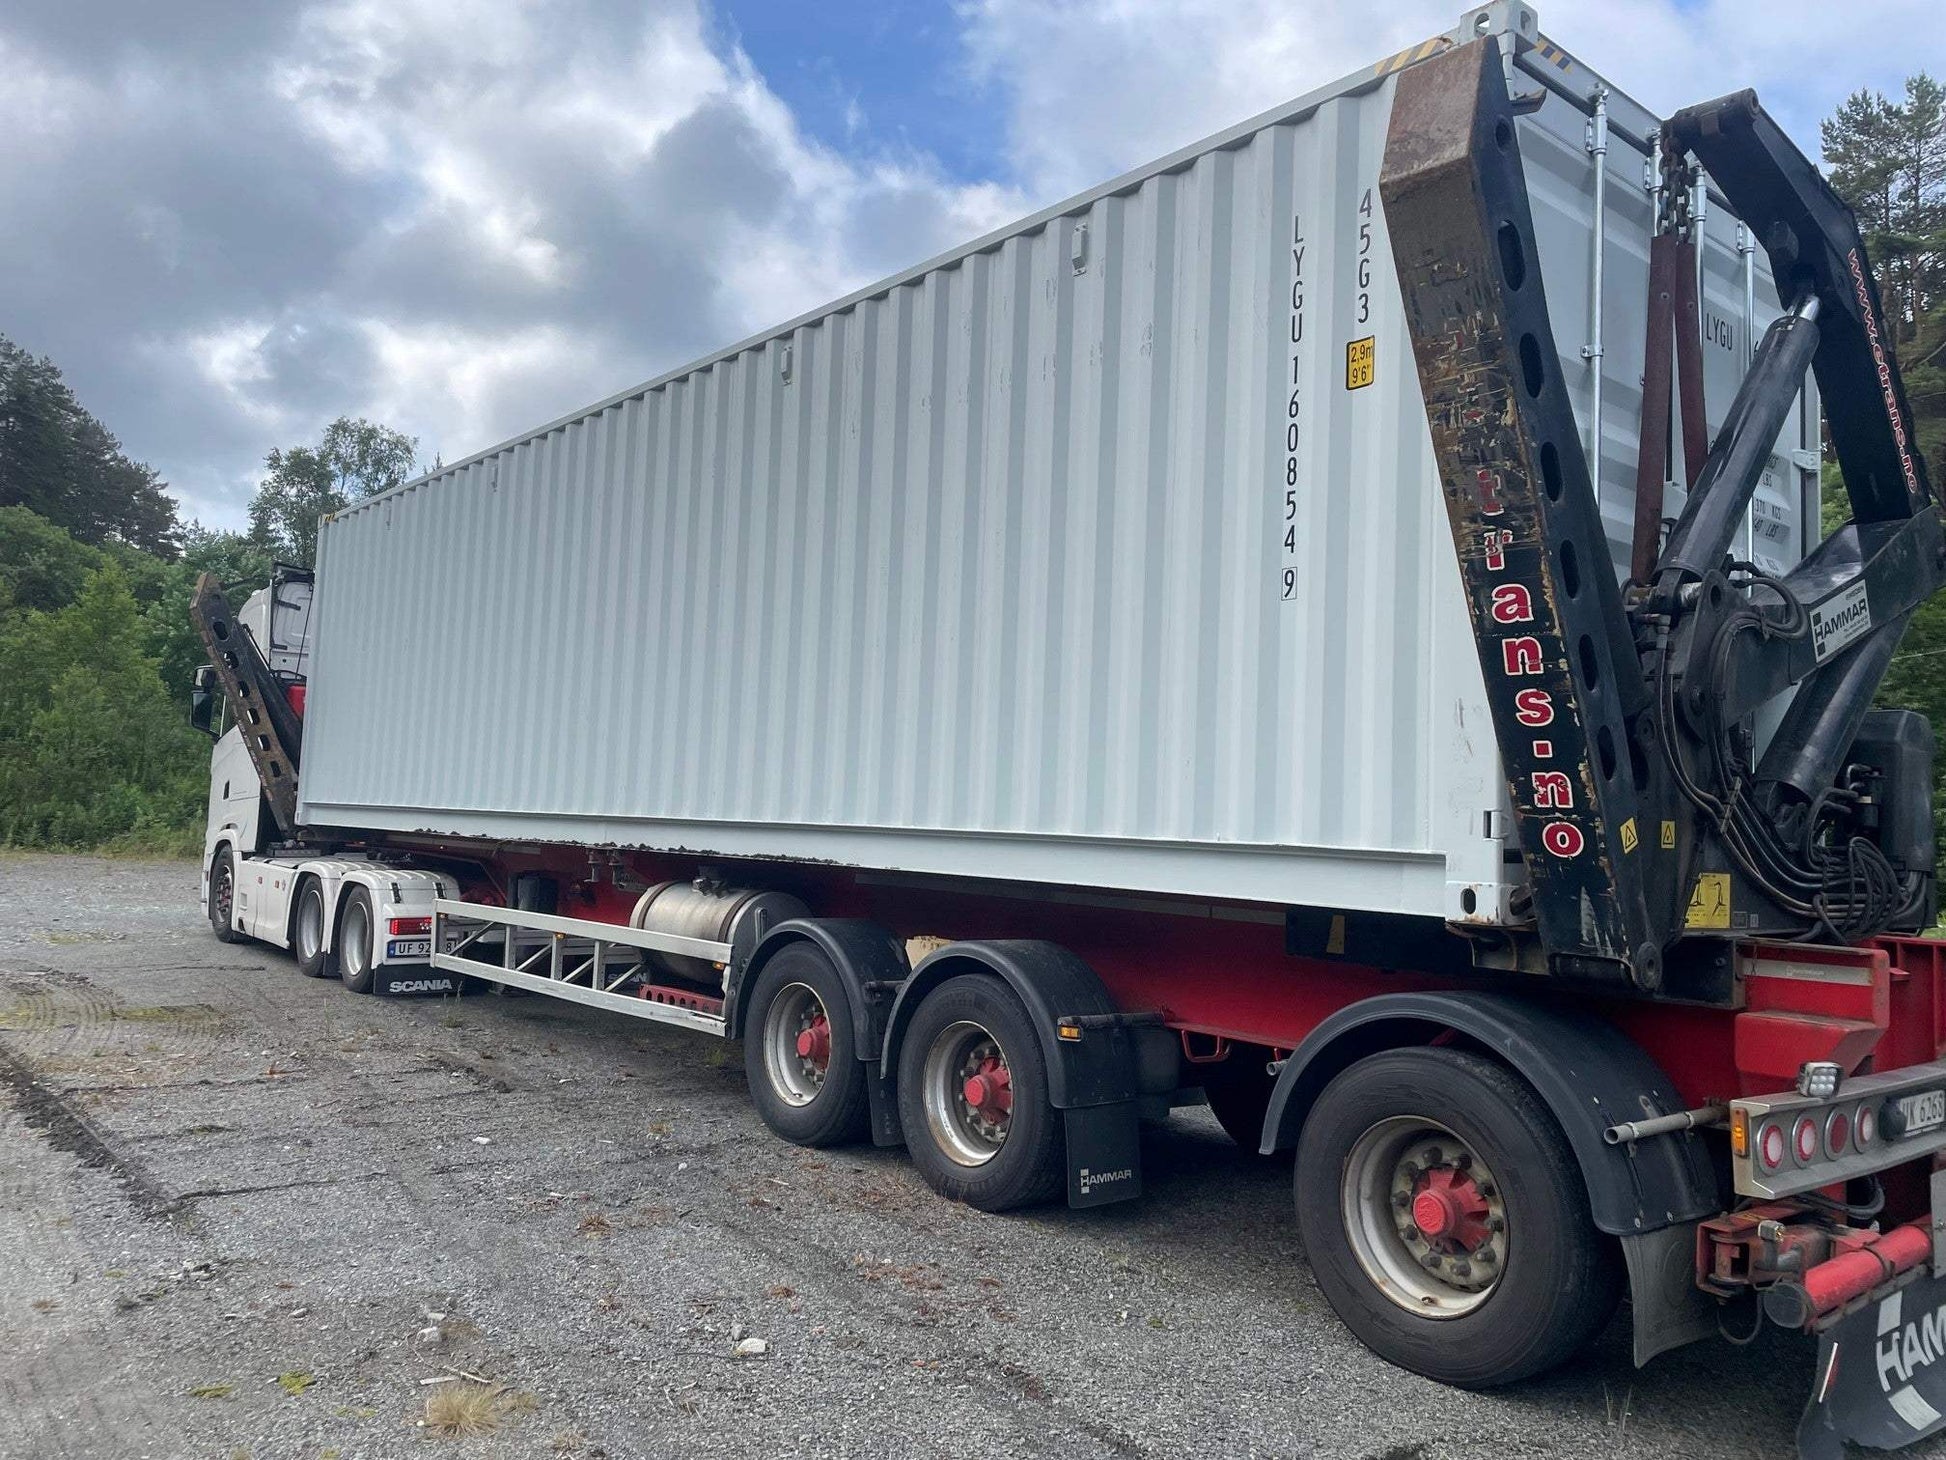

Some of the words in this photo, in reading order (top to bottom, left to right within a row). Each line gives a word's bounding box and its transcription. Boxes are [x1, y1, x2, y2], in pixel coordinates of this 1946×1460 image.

[1358, 188, 1372, 324] 45G3
[1291, 215, 1305, 343] LYGU
[1705, 312, 1733, 351] LYGU
[1284, 355, 1300, 554] 160854
[1814, 597, 1868, 644] HAMMAR
[398, 942, 413, 954] UF
[389, 979, 453, 993] SCANIA
[1080, 1169, 1132, 1187] HAMMAR
